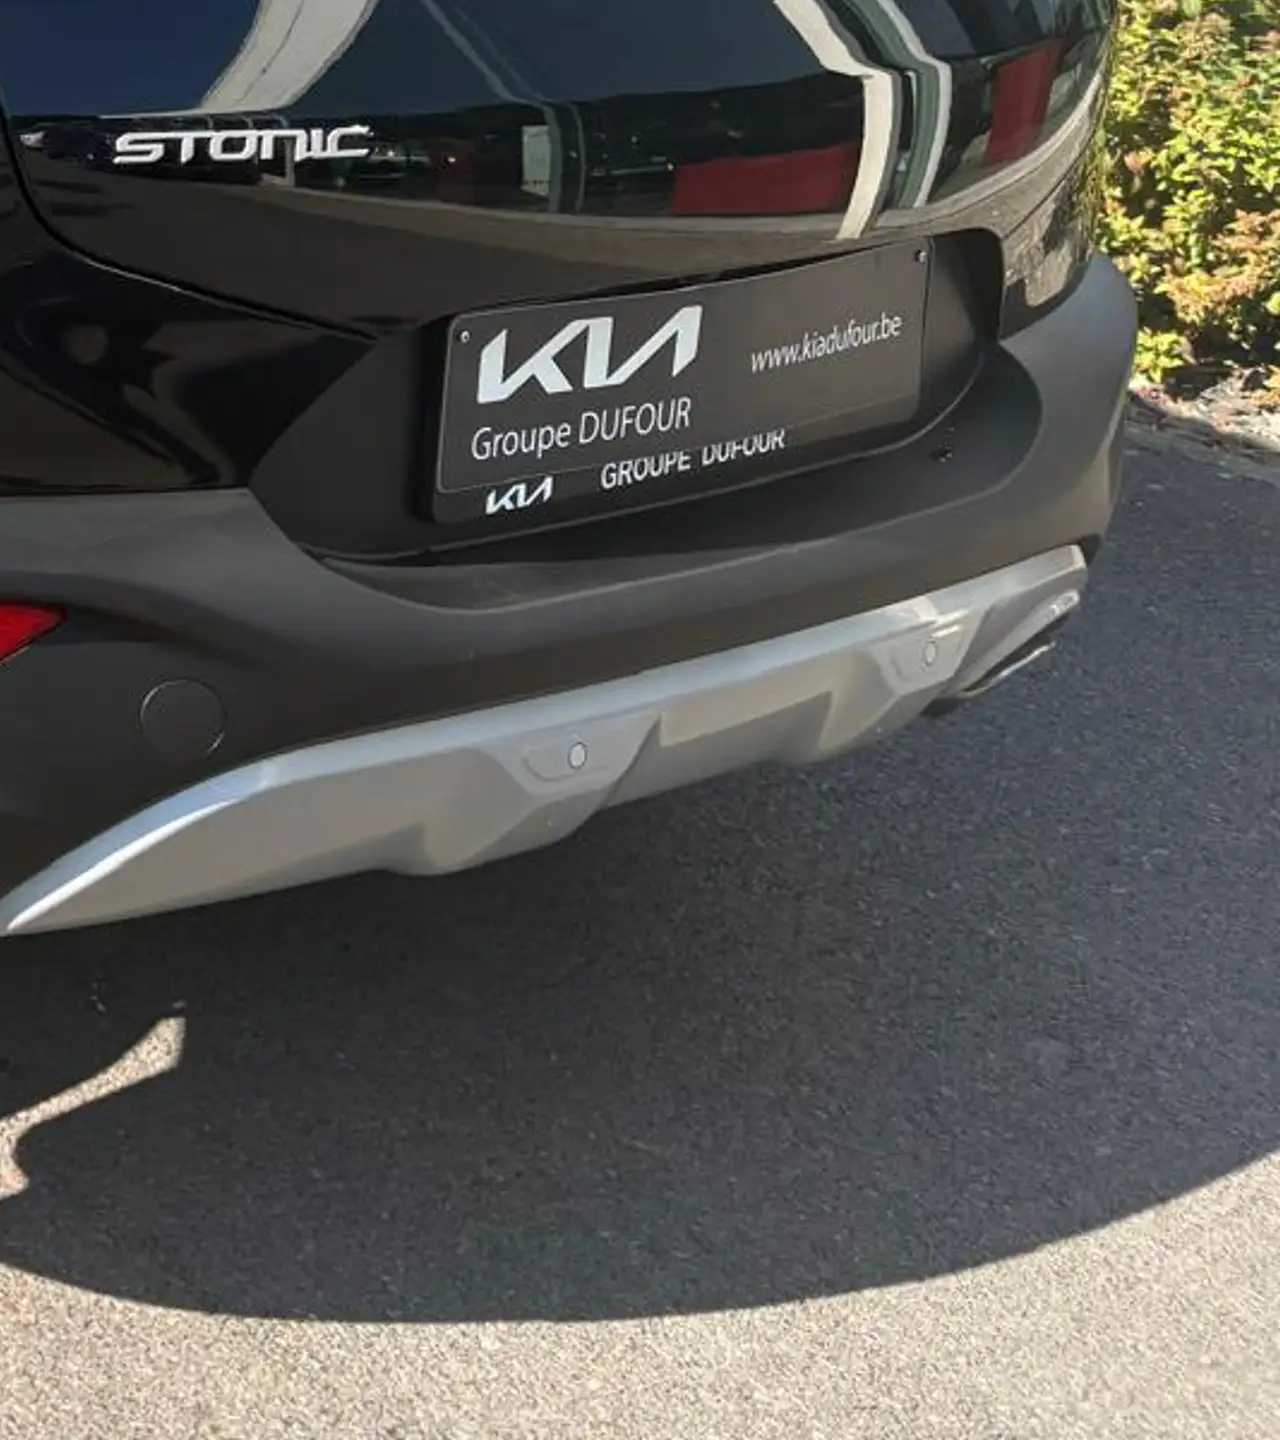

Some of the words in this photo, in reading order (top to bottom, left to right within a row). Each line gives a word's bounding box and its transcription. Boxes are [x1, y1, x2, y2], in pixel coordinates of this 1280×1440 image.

[112, 124, 375, 165] STONIC
[477, 304, 704, 405] KIA
[750, 311, 904, 374] www.kiadufour.be
[471, 422, 572, 461] Groupe
[578, 396, 692, 446] DUFOUR
[485, 475, 554, 516] KIA
[600, 449, 692, 490] GROUPE
[701, 428, 786, 467] DUFOUR
